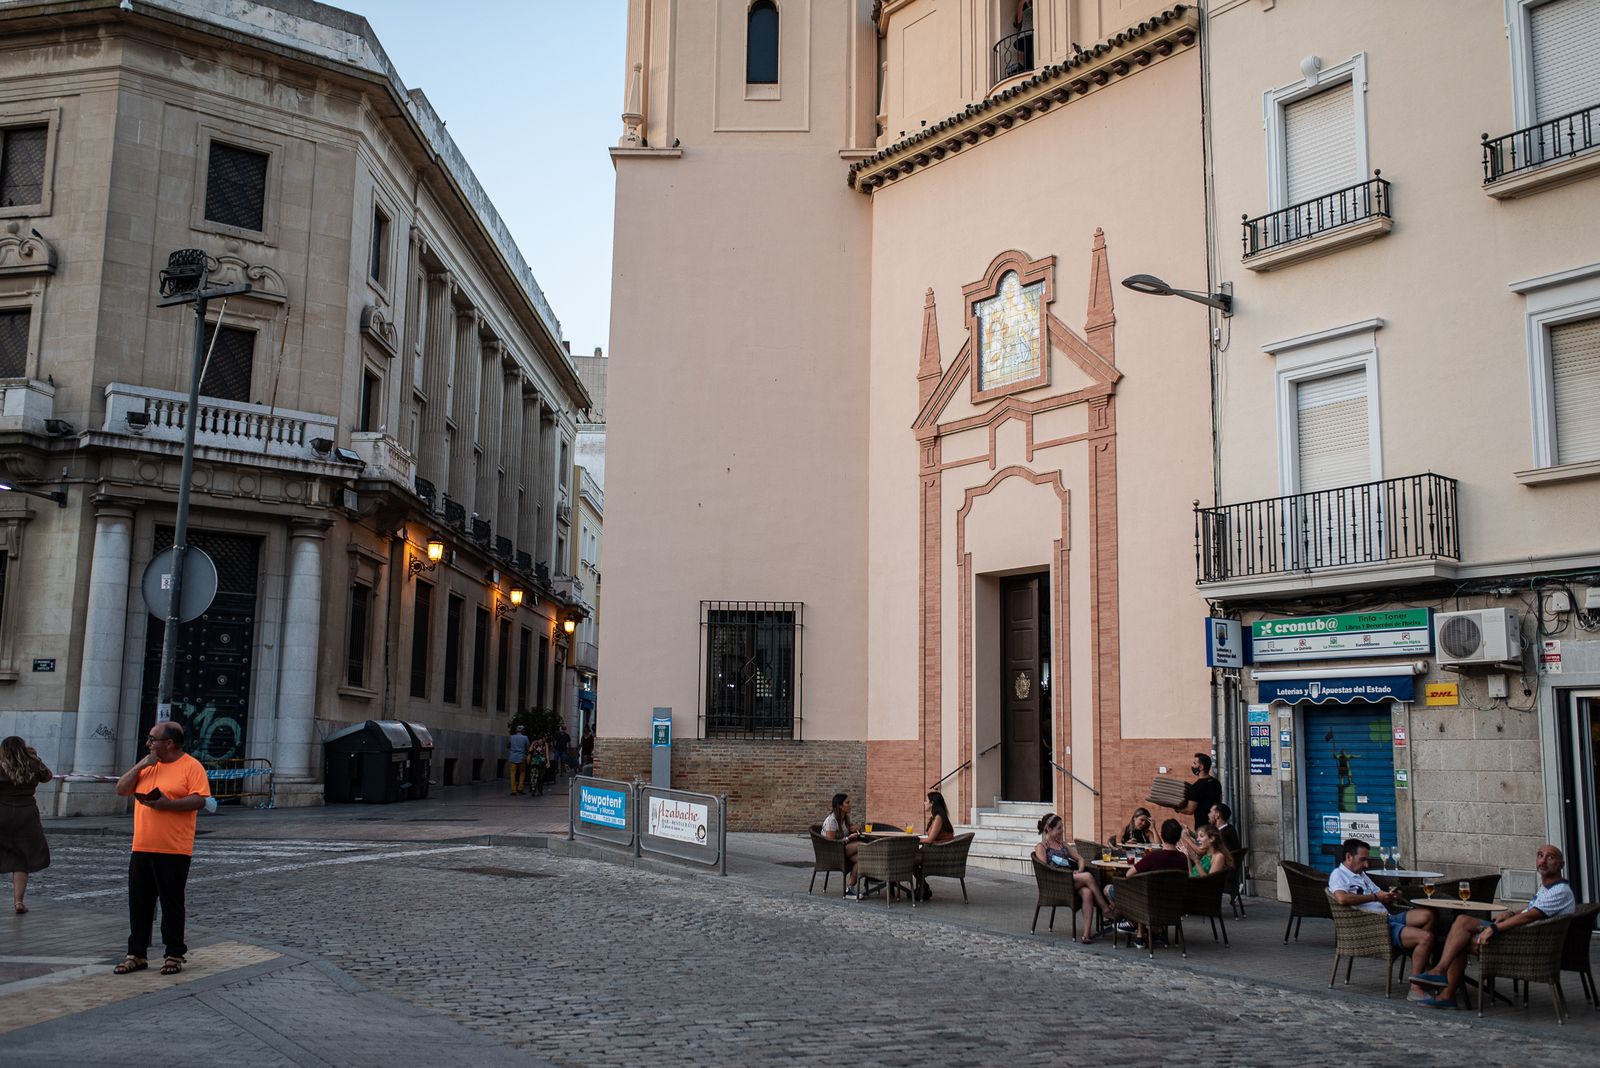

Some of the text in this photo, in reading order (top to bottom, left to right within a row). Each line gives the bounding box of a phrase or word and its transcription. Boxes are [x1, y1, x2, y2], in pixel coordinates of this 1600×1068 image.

[1384, 612, 1407, 621] Toner
[1275, 617, 1338, 633] cronub@
[1304, 688, 1309, 696] y
[1321, 686, 1353, 694] Apuestas
[1366, 685, 1392, 693] Estado
[582, 789, 622, 808] Newpatent
[657, 800, 698, 826] Azabache
